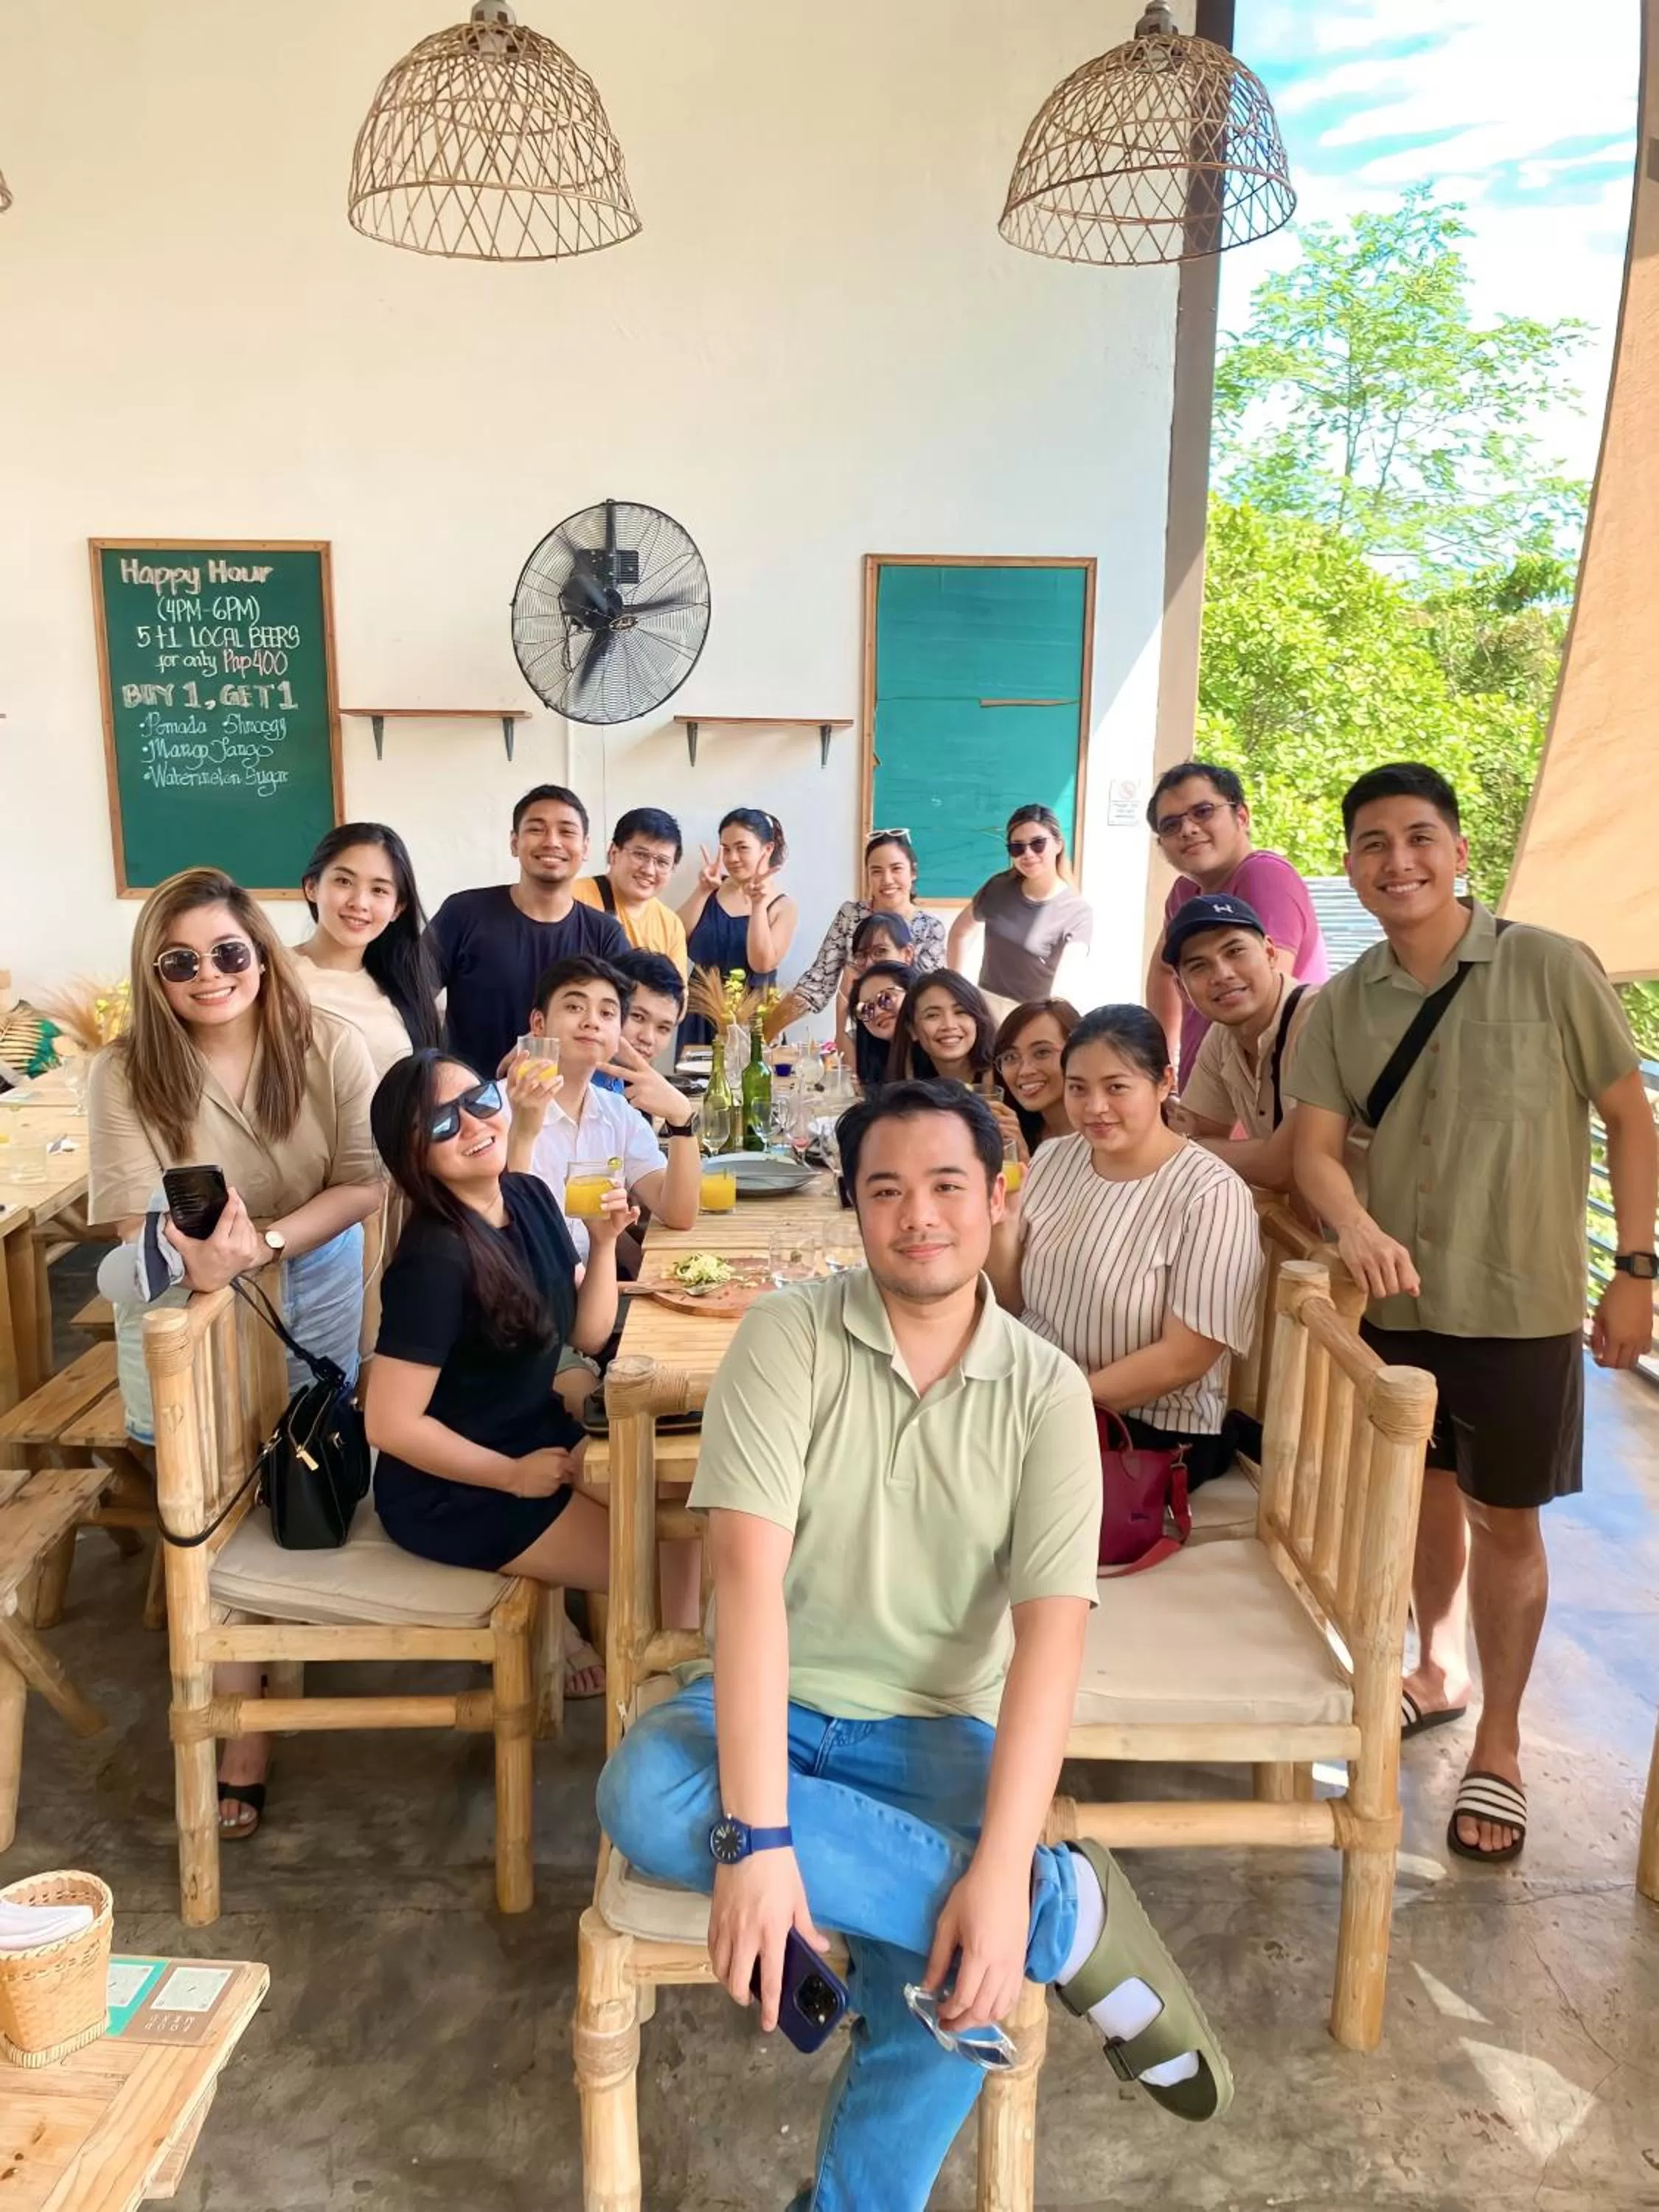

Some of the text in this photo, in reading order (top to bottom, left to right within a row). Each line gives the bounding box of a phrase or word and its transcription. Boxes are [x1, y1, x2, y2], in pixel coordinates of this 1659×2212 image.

[120, 558, 274, 596] Happy Hour
[157, 596, 260, 627] (4PM-6PM)
[189, 627, 244, 648] LOCAL
[249, 625, 300, 649] BEERS
[156, 654, 179, 673] for
[183, 650, 218, 677] only
[122, 683, 175, 709] BUY
[219, 684, 275, 709] GET
[277, 681, 299, 709] 1
[142, 737, 274, 770] Mango Tango
[149, 761, 288, 797] Watermelon Sugar
